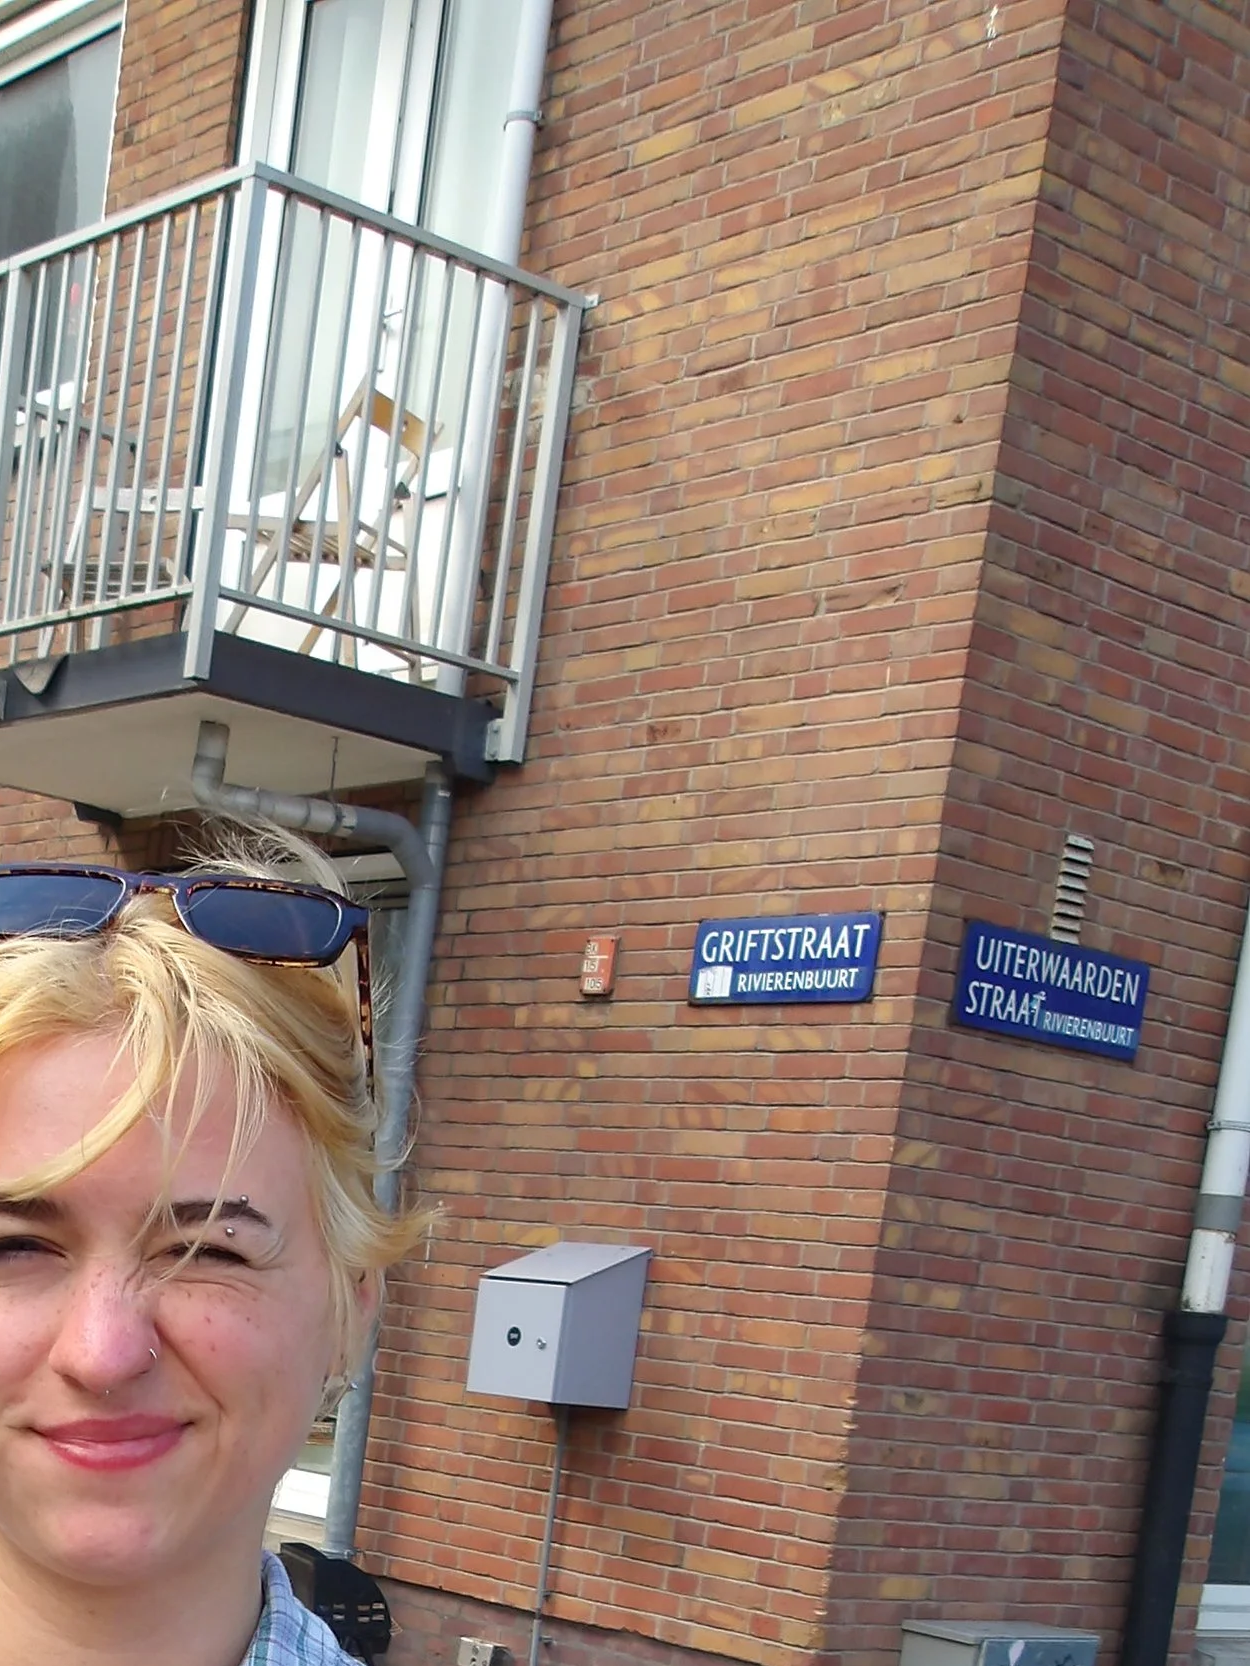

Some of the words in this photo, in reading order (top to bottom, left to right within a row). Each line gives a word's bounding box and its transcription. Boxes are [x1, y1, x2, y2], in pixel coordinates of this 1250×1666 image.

[702, 924, 870, 963] GRIFTSTRAAT
[737, 968, 858, 992] RIVIERENBUURT
[976, 935, 1140, 1006] UITERWAARDEN
[965, 980, 1046, 1027] STRAAT
[1043, 1011, 1134, 1046] RIVIERENBUURT
